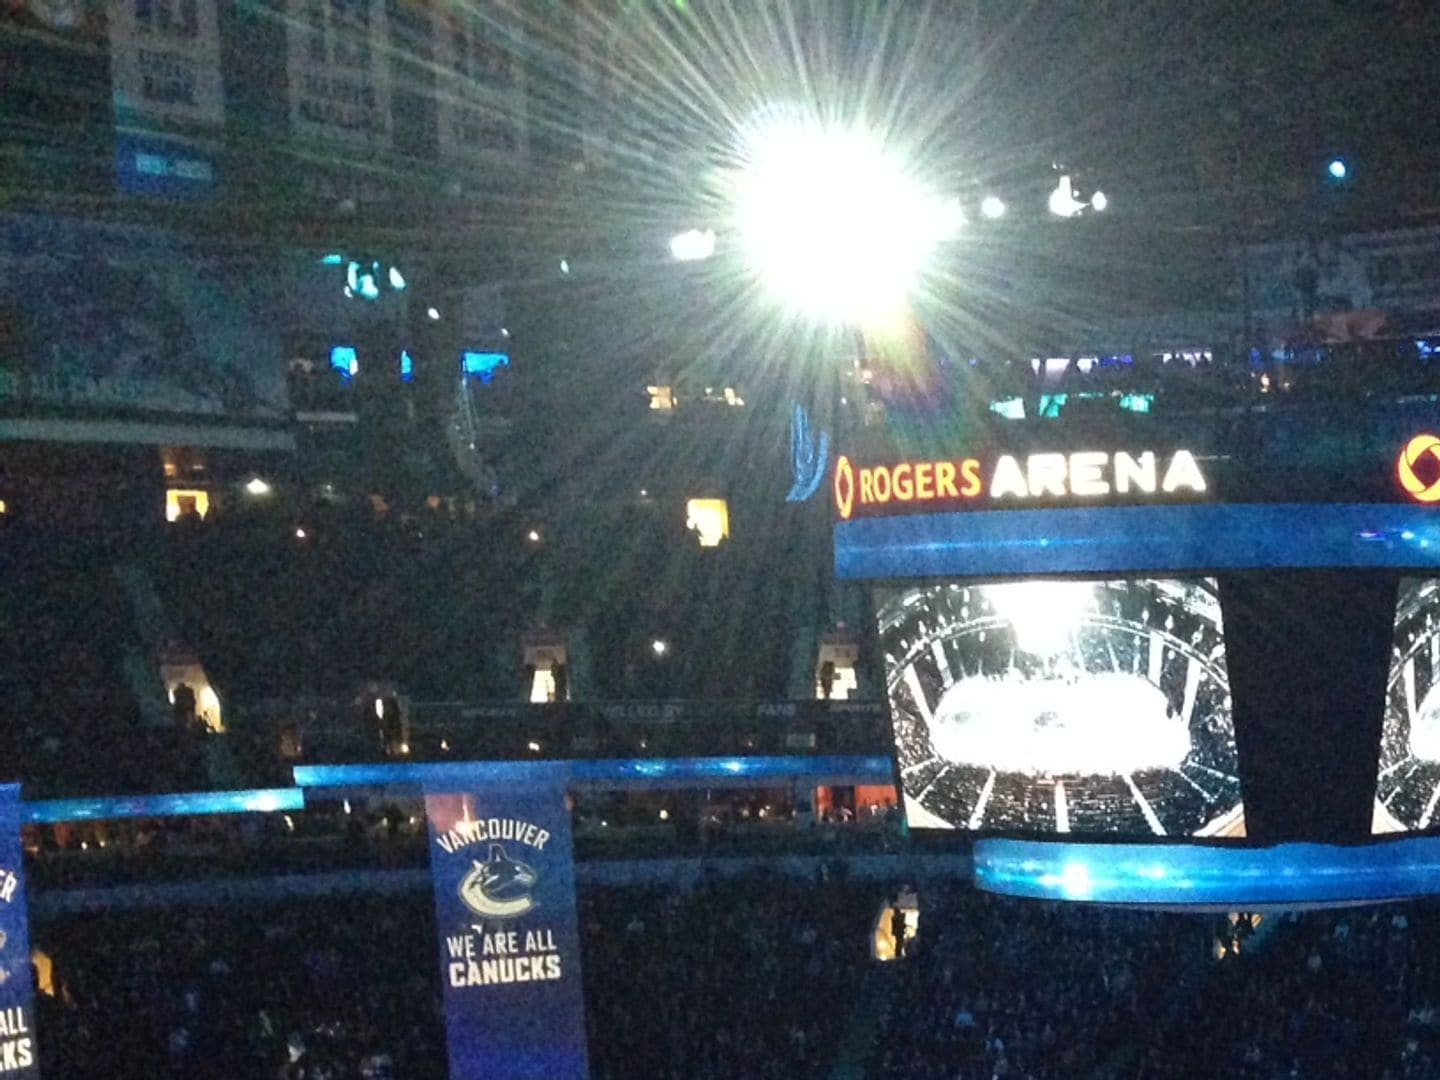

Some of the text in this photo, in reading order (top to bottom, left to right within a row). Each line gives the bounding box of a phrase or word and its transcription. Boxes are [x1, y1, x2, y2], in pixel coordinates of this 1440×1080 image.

[859, 449, 1208, 503] ROGERS ARENA
[436, 818, 551, 854] VANCOUVER
[446, 929, 558, 958] WE ARE ALL
[448, 954, 562, 988] CANUCKS
